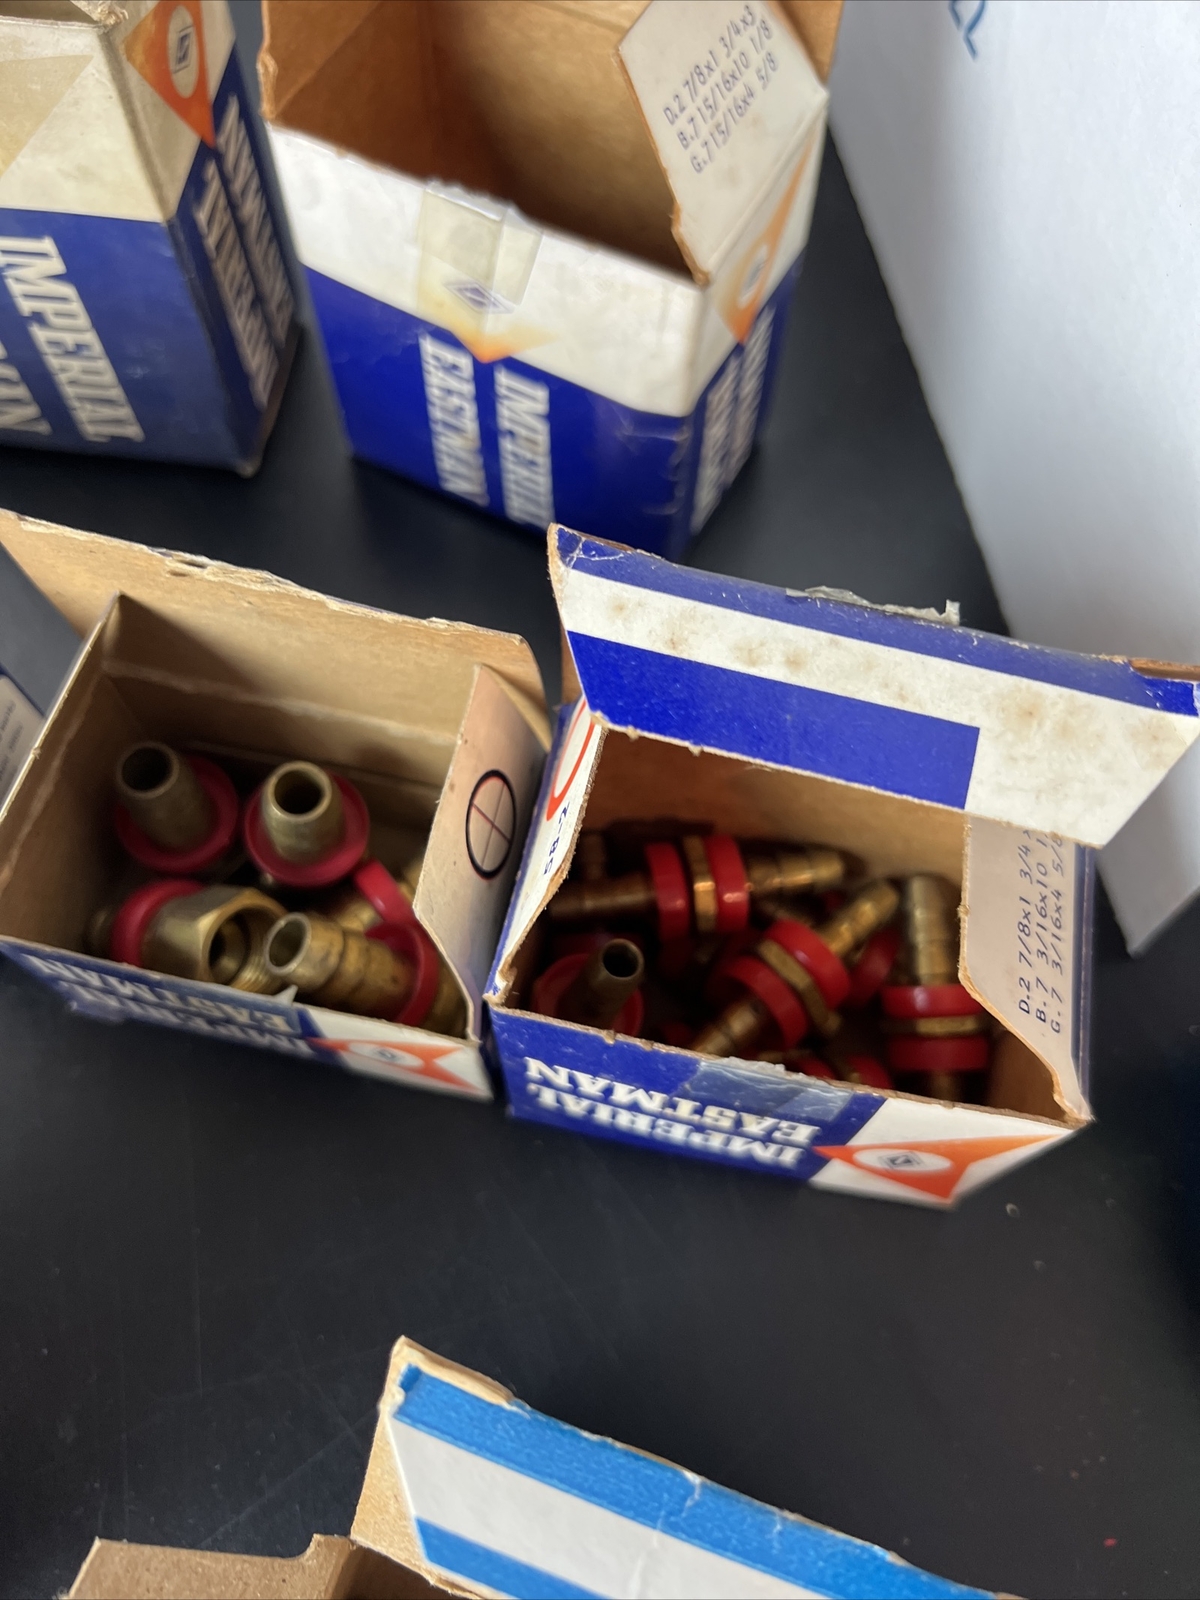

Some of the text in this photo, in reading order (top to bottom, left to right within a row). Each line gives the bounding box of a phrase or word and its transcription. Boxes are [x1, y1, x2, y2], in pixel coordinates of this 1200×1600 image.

[749, 18, 773, 55] 1/8
[755, 51, 779, 91] 5/8
[0, 235, 145, 443] IMPERIAL
[418, 331, 490, 507] EASTMAN
[1017, 896, 1033, 968] 7/8x1
[1035, 862, 1050, 965] 3/16x10
[1050, 889, 1064, 976] 3/16x4
[1018, 977, 1031, 1014] D.2
[523, 1056, 822, 1147] EASTMAN
[525, 1082, 807, 1170] IMPERIAL
